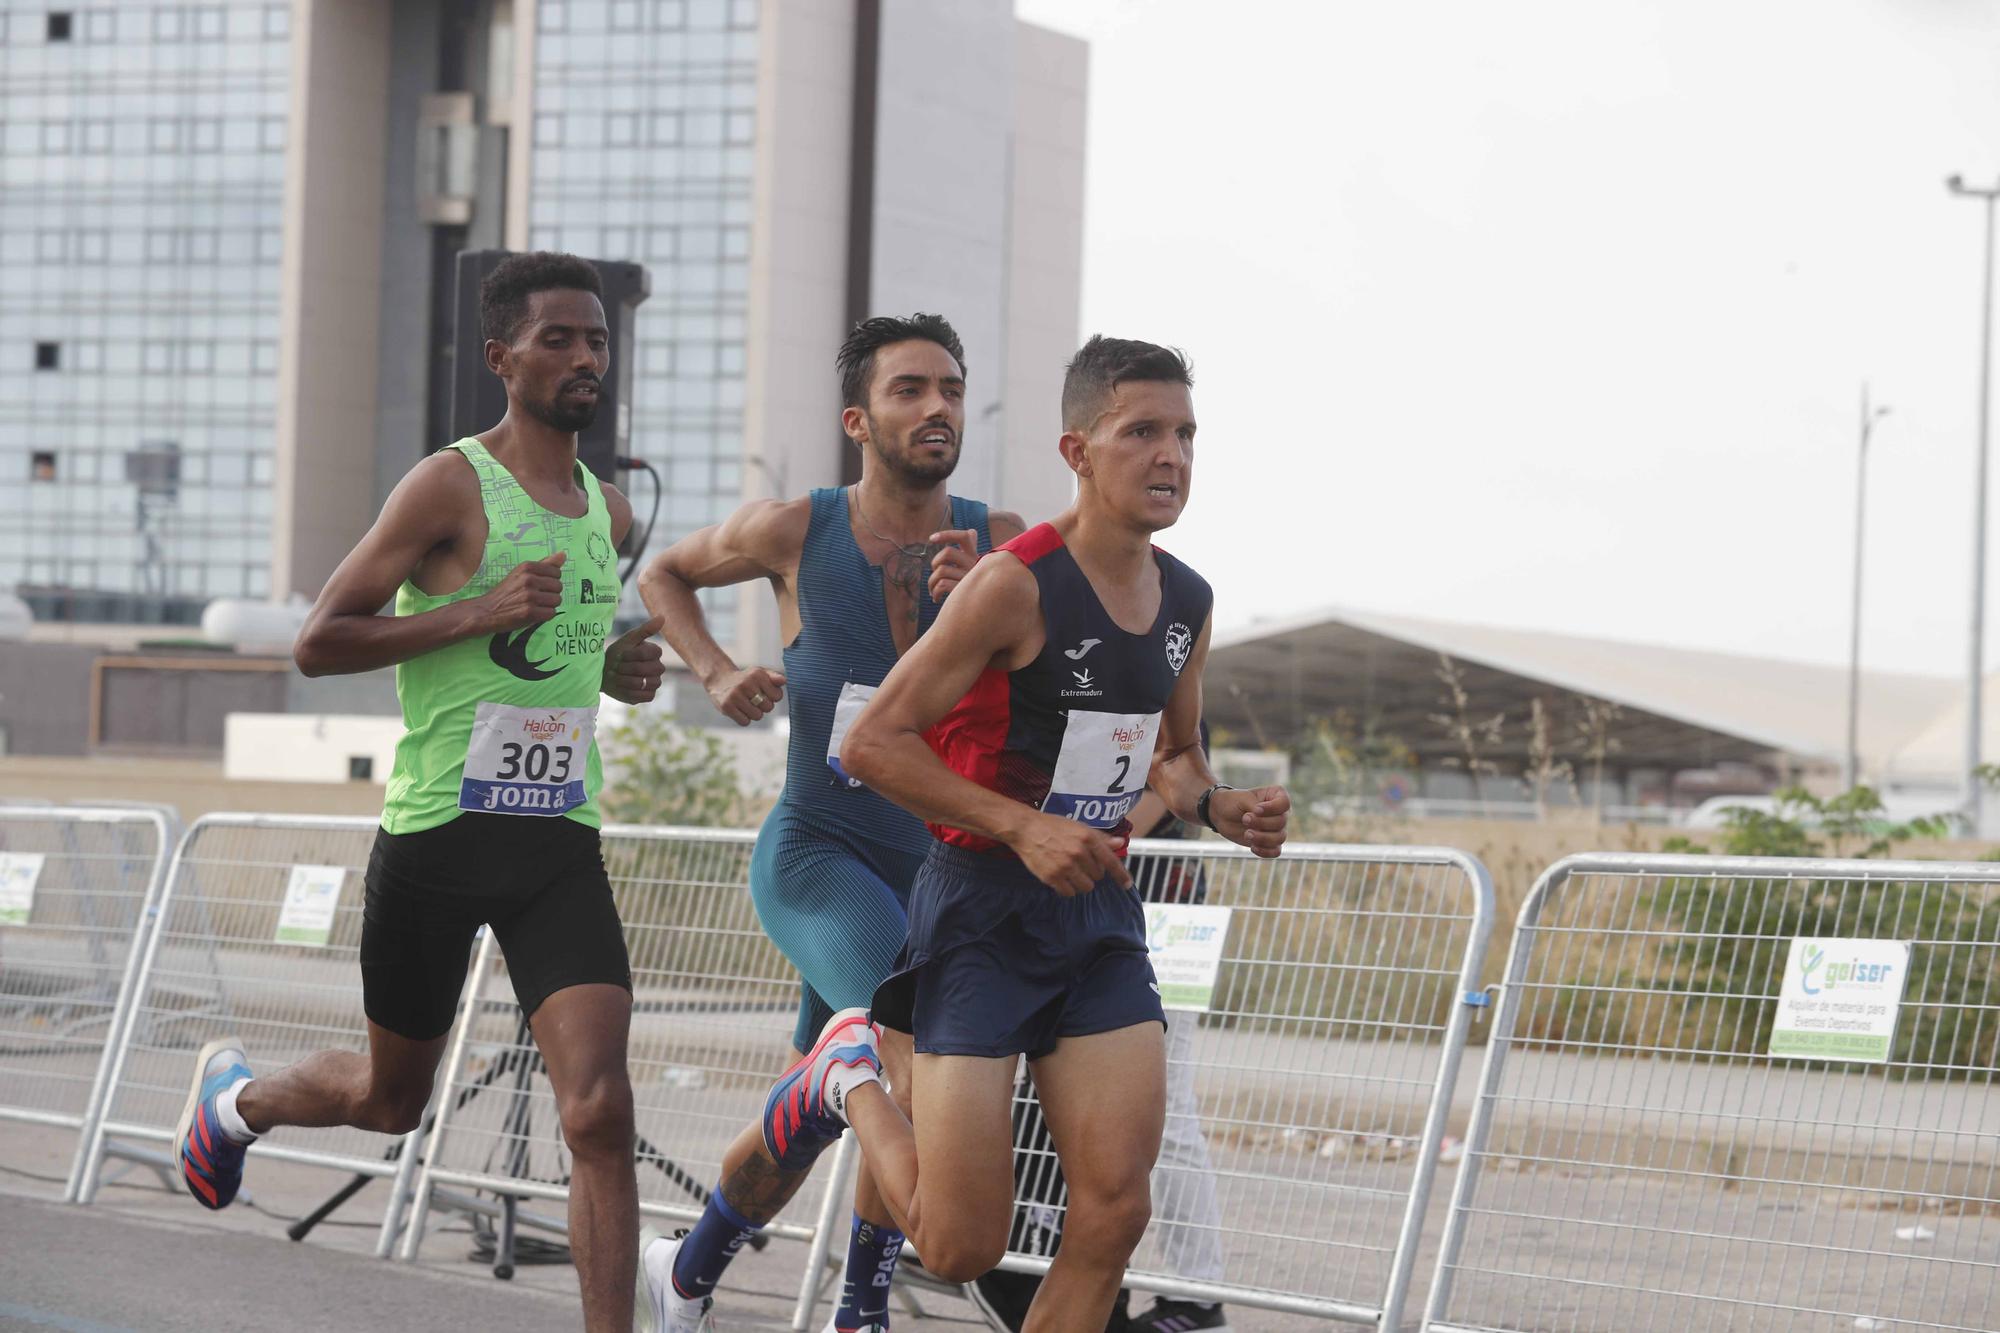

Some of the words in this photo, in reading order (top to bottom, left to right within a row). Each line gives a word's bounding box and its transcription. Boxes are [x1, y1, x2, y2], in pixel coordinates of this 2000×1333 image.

[496, 742, 573, 783] 303
[1107, 755, 1131, 794] 2
[872, 1236, 902, 1287] PAST
